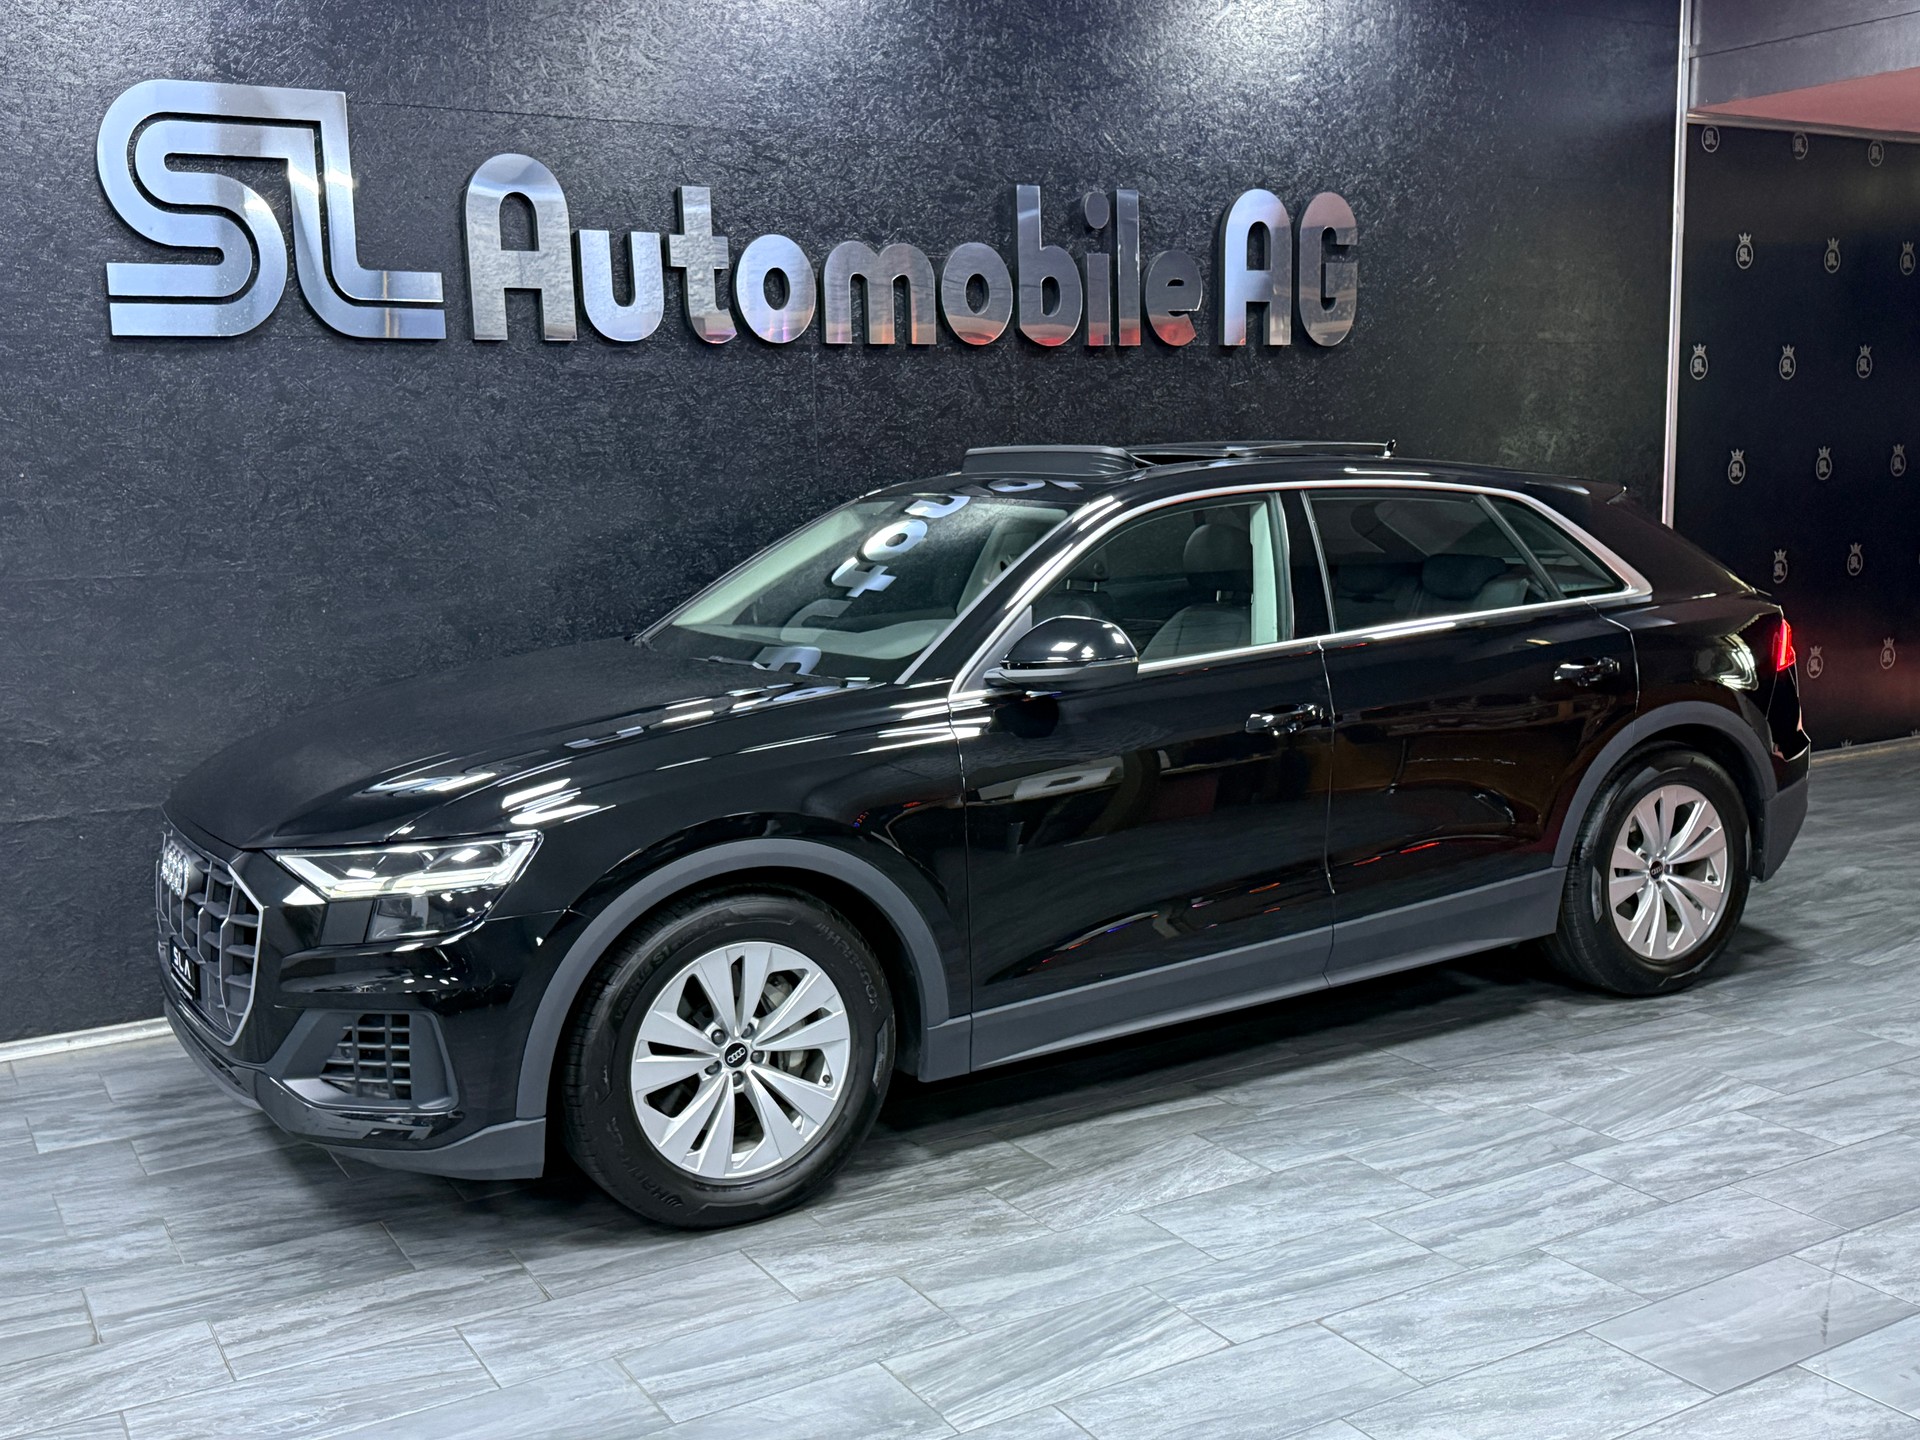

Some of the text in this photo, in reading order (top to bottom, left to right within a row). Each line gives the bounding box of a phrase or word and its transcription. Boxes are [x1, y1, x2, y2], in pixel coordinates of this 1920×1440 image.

[97, 79, 1358, 347] SL Automobile AG
